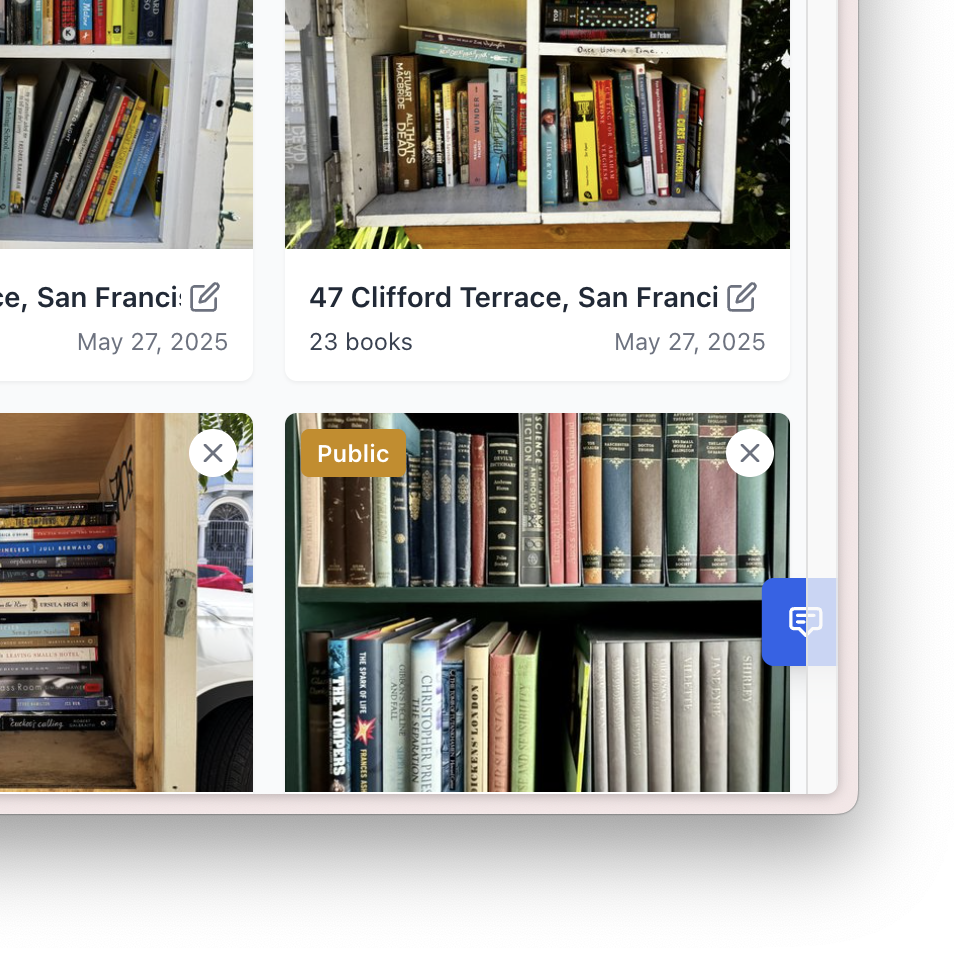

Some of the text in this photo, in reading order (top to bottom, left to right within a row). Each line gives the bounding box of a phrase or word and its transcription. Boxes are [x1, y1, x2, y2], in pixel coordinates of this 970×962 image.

[577, 46, 595, 54] Once
[395, 62, 405, 110] MACBRIDE
[404, 70, 412, 102] STUART
[396, 122, 406, 156] DEAD
[38, 286, 86, 308] San
[310, 285, 718, 313] 47 Clifford Terrace, San Franci
[79, 332, 227, 355] May 27, 2025
[310, 332, 412, 351] 23 books
[616, 332, 765, 355] May 27, 2025
[318, 443, 388, 463] Public
[524, 417, 532, 462] FICTION
[534, 416, 543, 464] SCIENCE
[359, 652, 367, 714] THE SPARK OF LIFE
[683, 657, 692, 712] VILLETTE
[742, 655, 752, 703] SHIRLEY
[332, 675, 346, 776] THE YOMPERS
[471, 685, 479, 734] LONDON
[412, 699, 420, 783] THE SEPARATION
